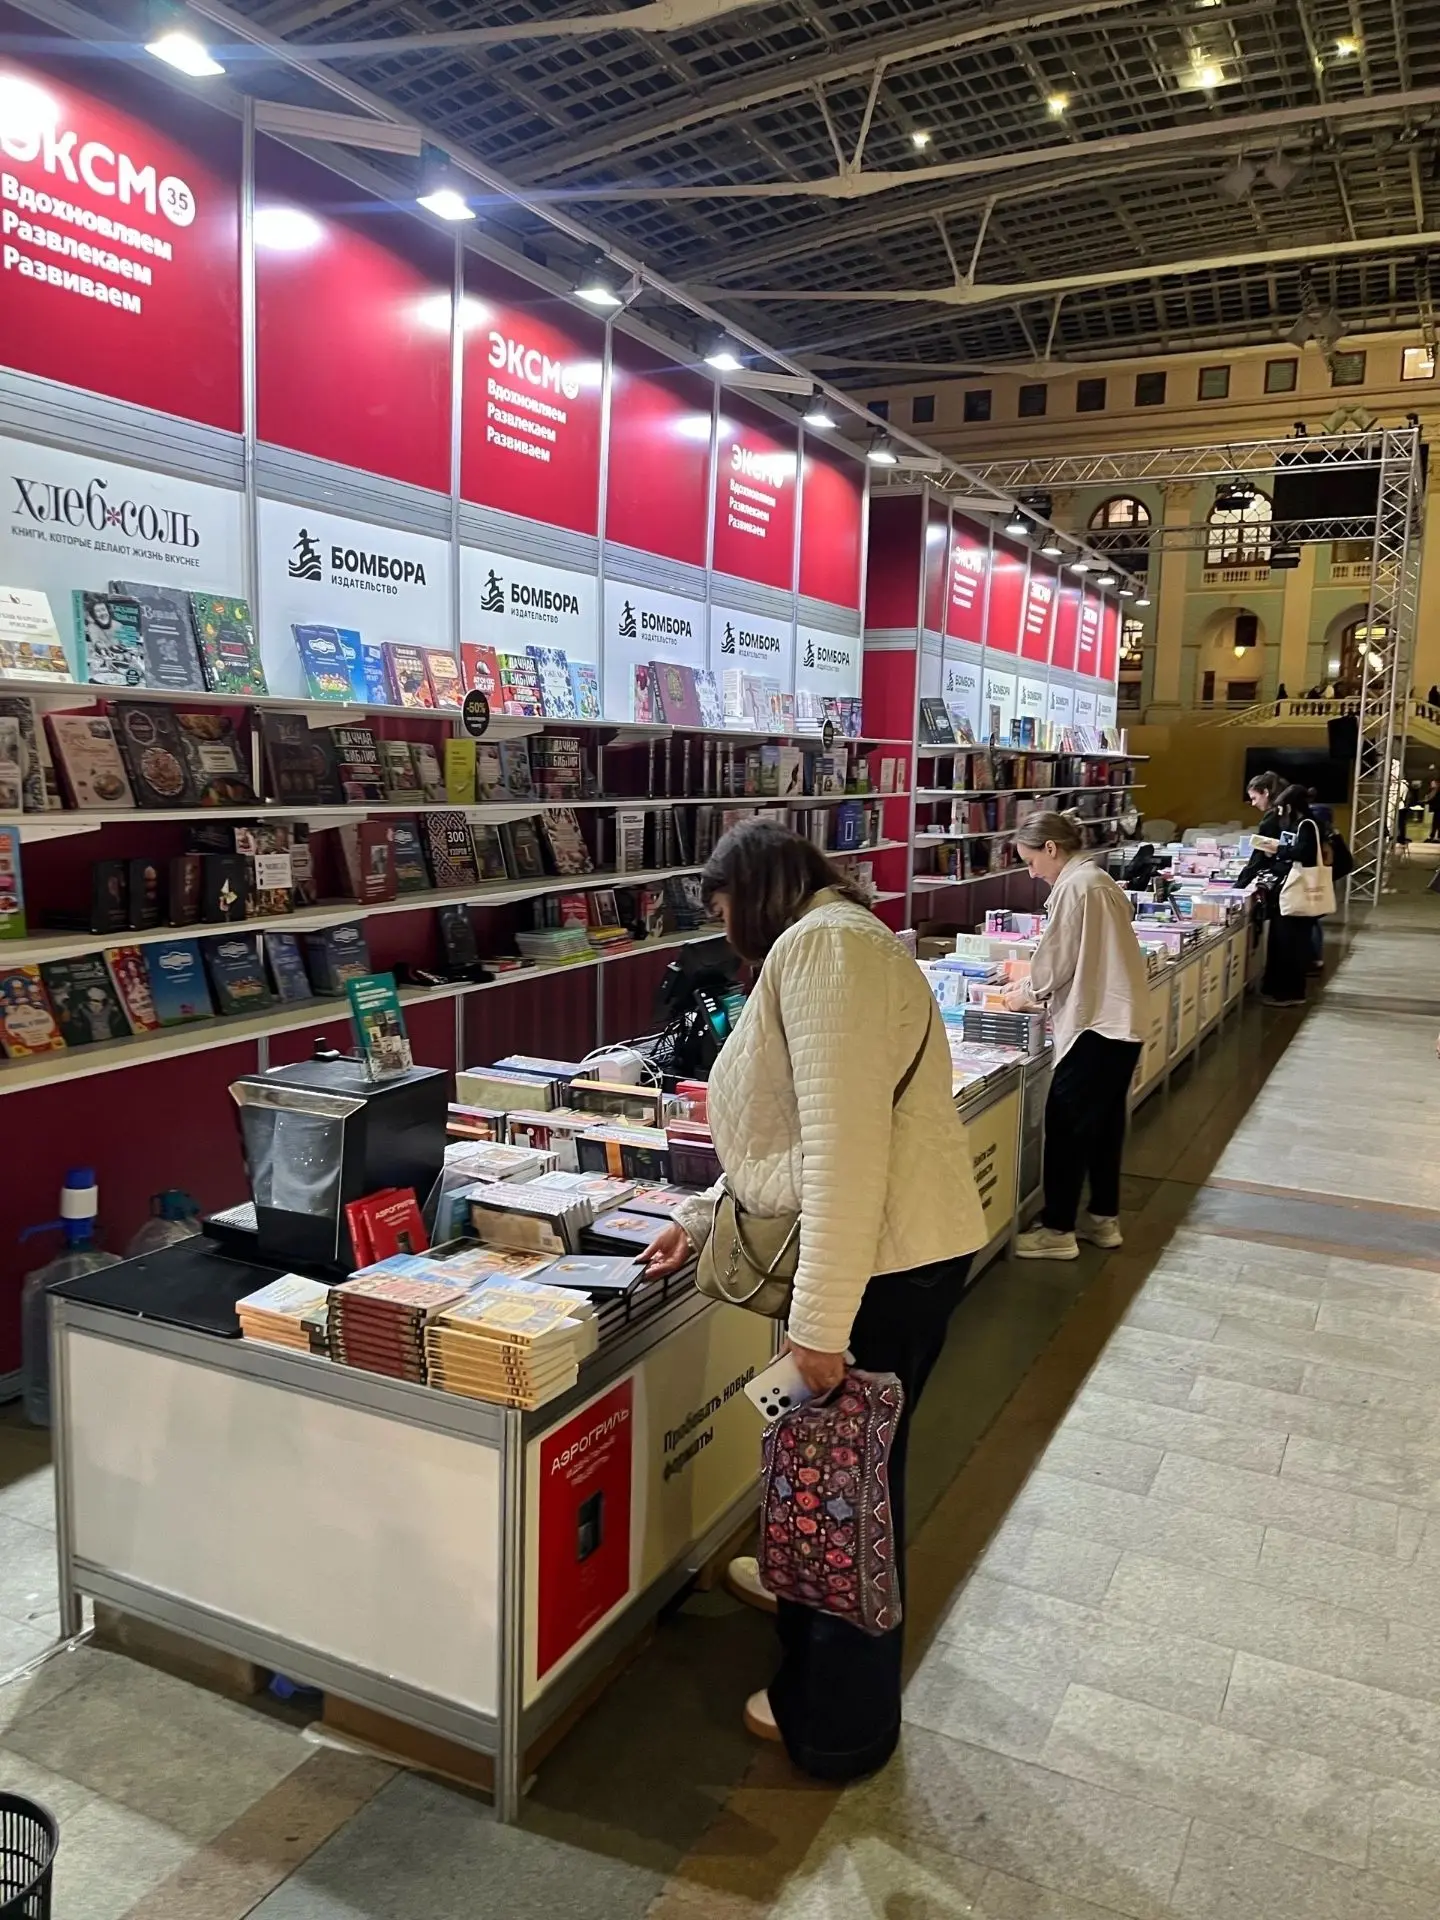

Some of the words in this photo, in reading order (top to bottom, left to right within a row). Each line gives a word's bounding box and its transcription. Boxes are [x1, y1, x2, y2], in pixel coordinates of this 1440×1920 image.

[1, 172, 173, 262] Вдохновляем
[2, 208, 153, 286] Развлекаем
[3, 244, 142, 315] Развиваем
[487, 377, 567, 425] Вдохновляем
[487, 401, 557, 443] Развлекаем
[486, 425, 551, 463] Развиваем
[11, 525, 48, 542] КНИГИ,
[49, 531, 92, 549] КОТОРЫЕ
[94, 541, 131, 556] ДЕЛАЮТ
[132, 547, 163, 561] ЖИЗНЬ
[165, 553, 200, 568] ВКУСНЕЕ
[331, 545, 427, 586] БОМБОРА
[331, 574, 398, 595] ИЗДАТЕЛЬСТВО
[511, 583, 580, 615] БОМБОРА
[510, 607, 559, 624] ИЗДАТЕЛЬСТВО
[641, 611, 692, 638] БОМБОРА
[739, 631, 781, 653] БОМБОРА
[817, 647, 850, 666] БОМБОРА
[466, 700, 486, 714] -50%
[447, 831, 465, 843] 300
[723, 1365, 755, 1403] новые
[551, 1408, 630, 1476] АЭРОГРИЛЬ
